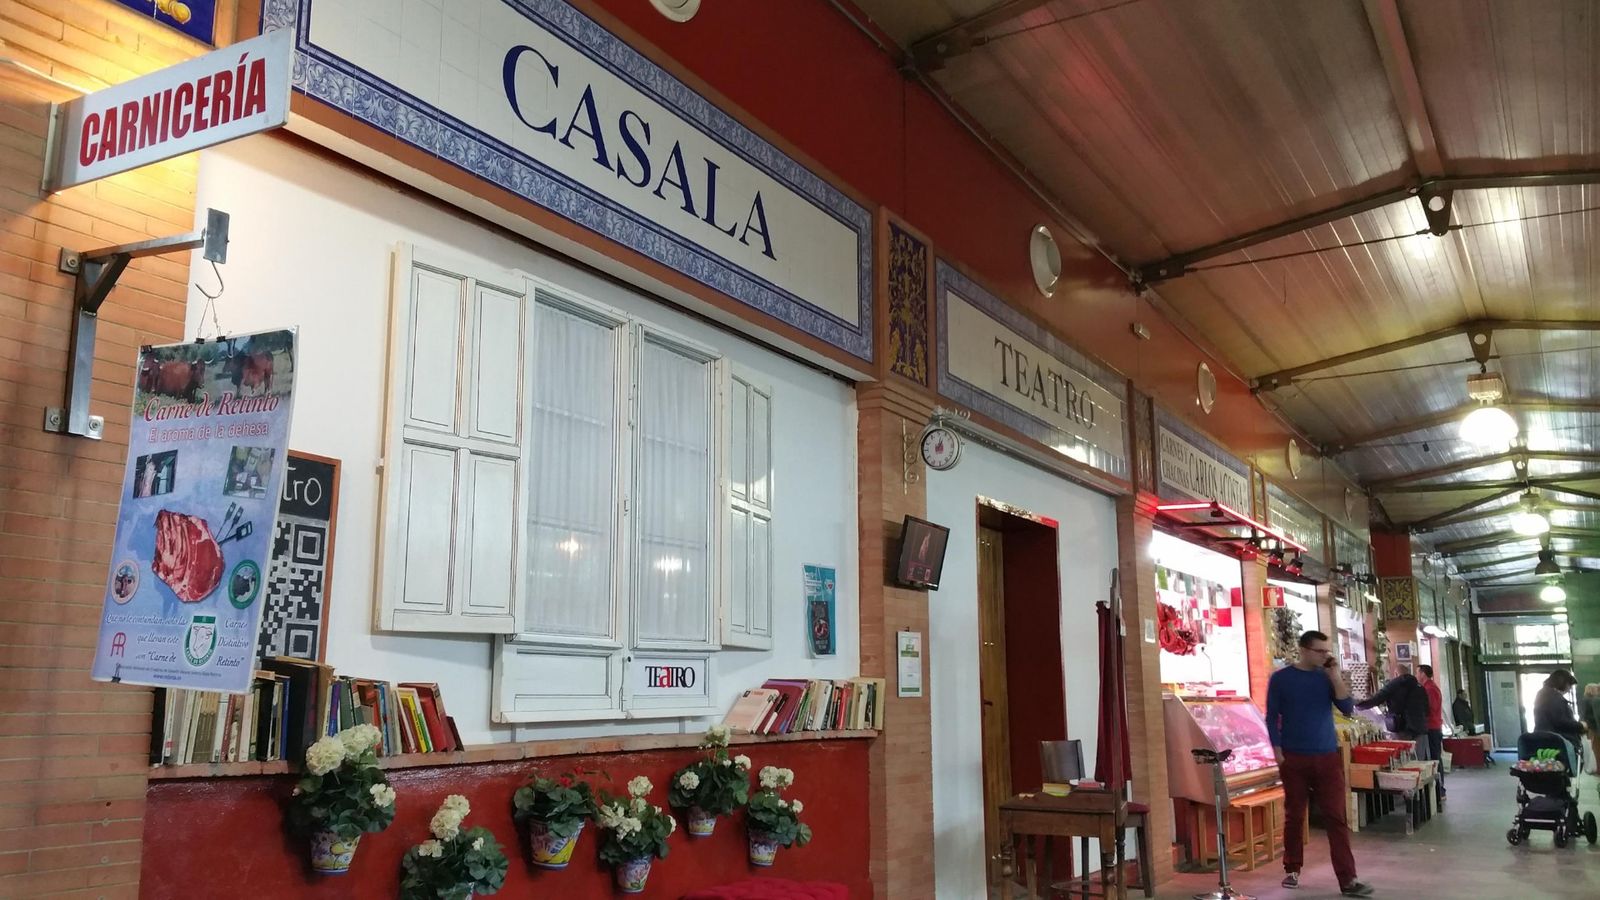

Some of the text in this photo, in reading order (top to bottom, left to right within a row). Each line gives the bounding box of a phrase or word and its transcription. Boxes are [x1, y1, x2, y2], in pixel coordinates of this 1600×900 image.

[79, 52, 267, 167] CARNICERÍA
[502, 44, 777, 261] CASALA
[144, 391, 279, 422] Carne de Retinto
[994, 335, 1094, 430] TEATRO
[149, 421, 269, 443] El aroma de la dehesa
